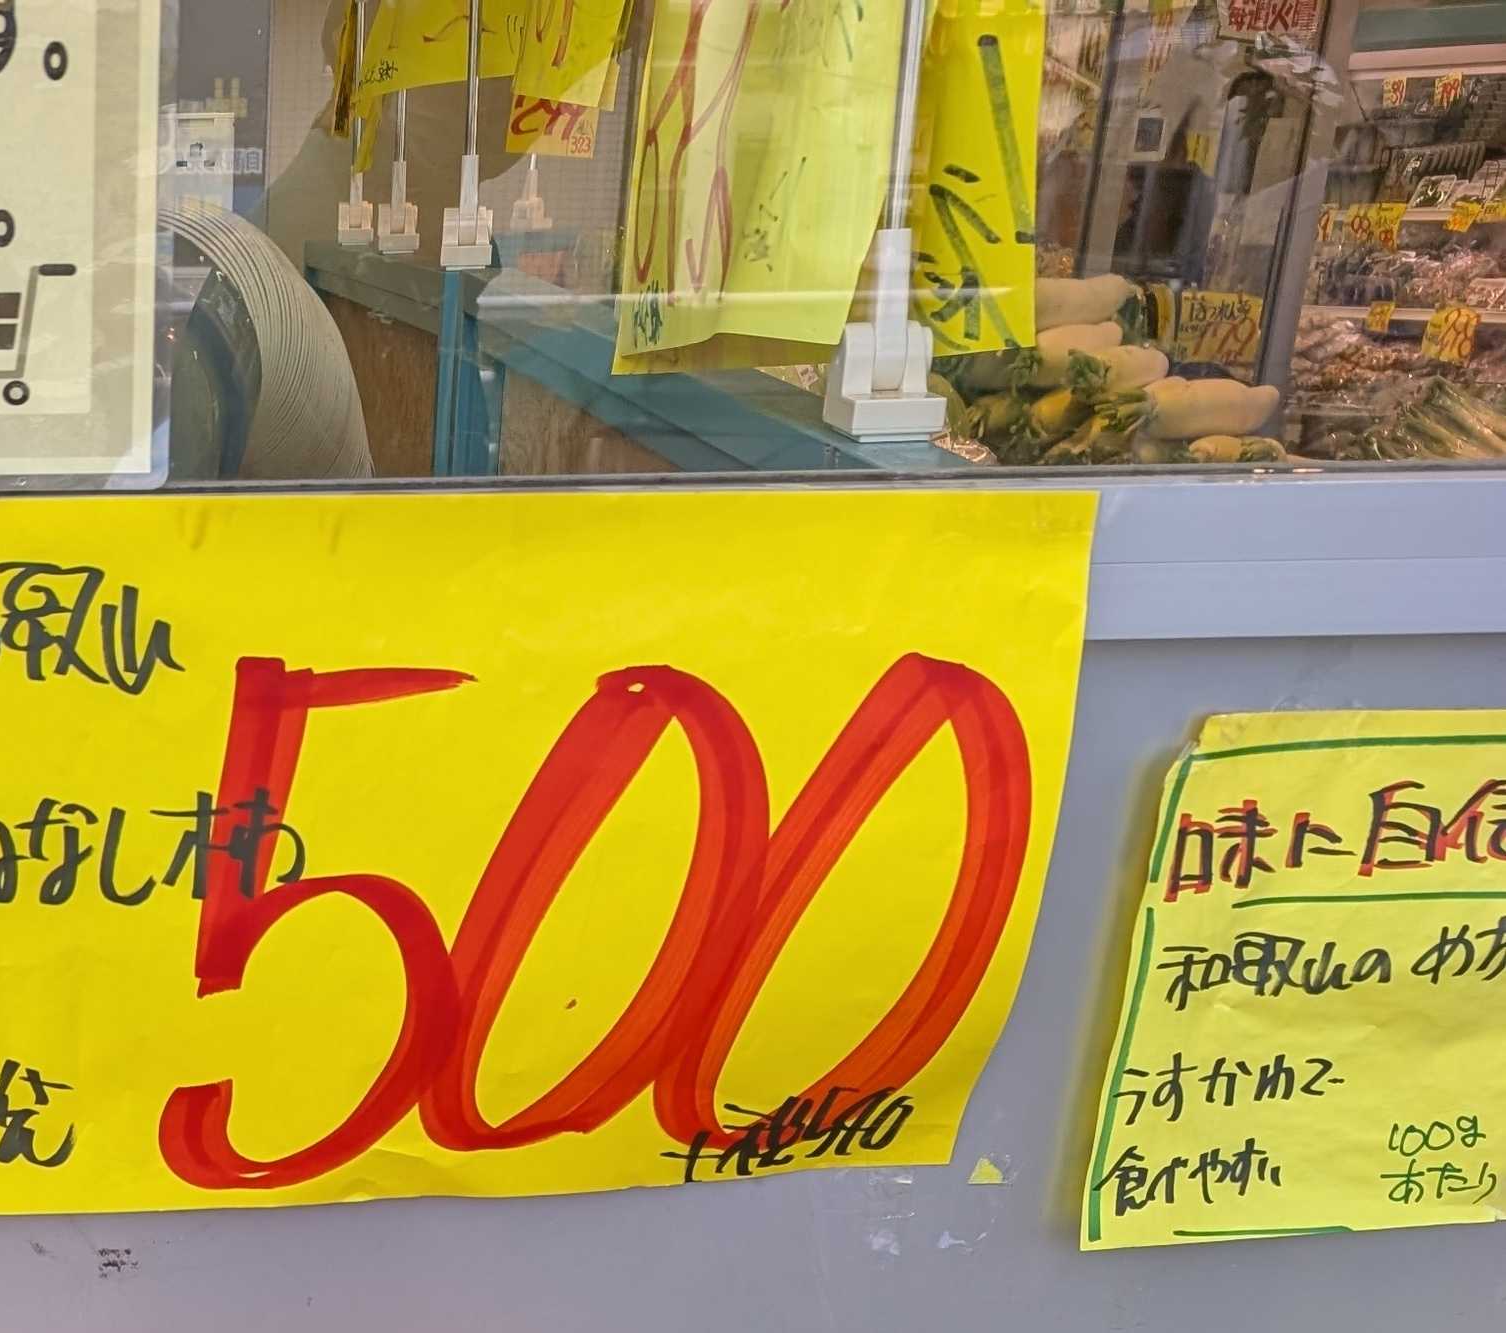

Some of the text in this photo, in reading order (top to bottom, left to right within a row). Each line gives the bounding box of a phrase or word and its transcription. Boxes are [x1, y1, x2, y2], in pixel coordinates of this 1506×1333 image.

[157, 650, 1033, 1190] 500
[1380, 1158, 1497, 1205] あたり
